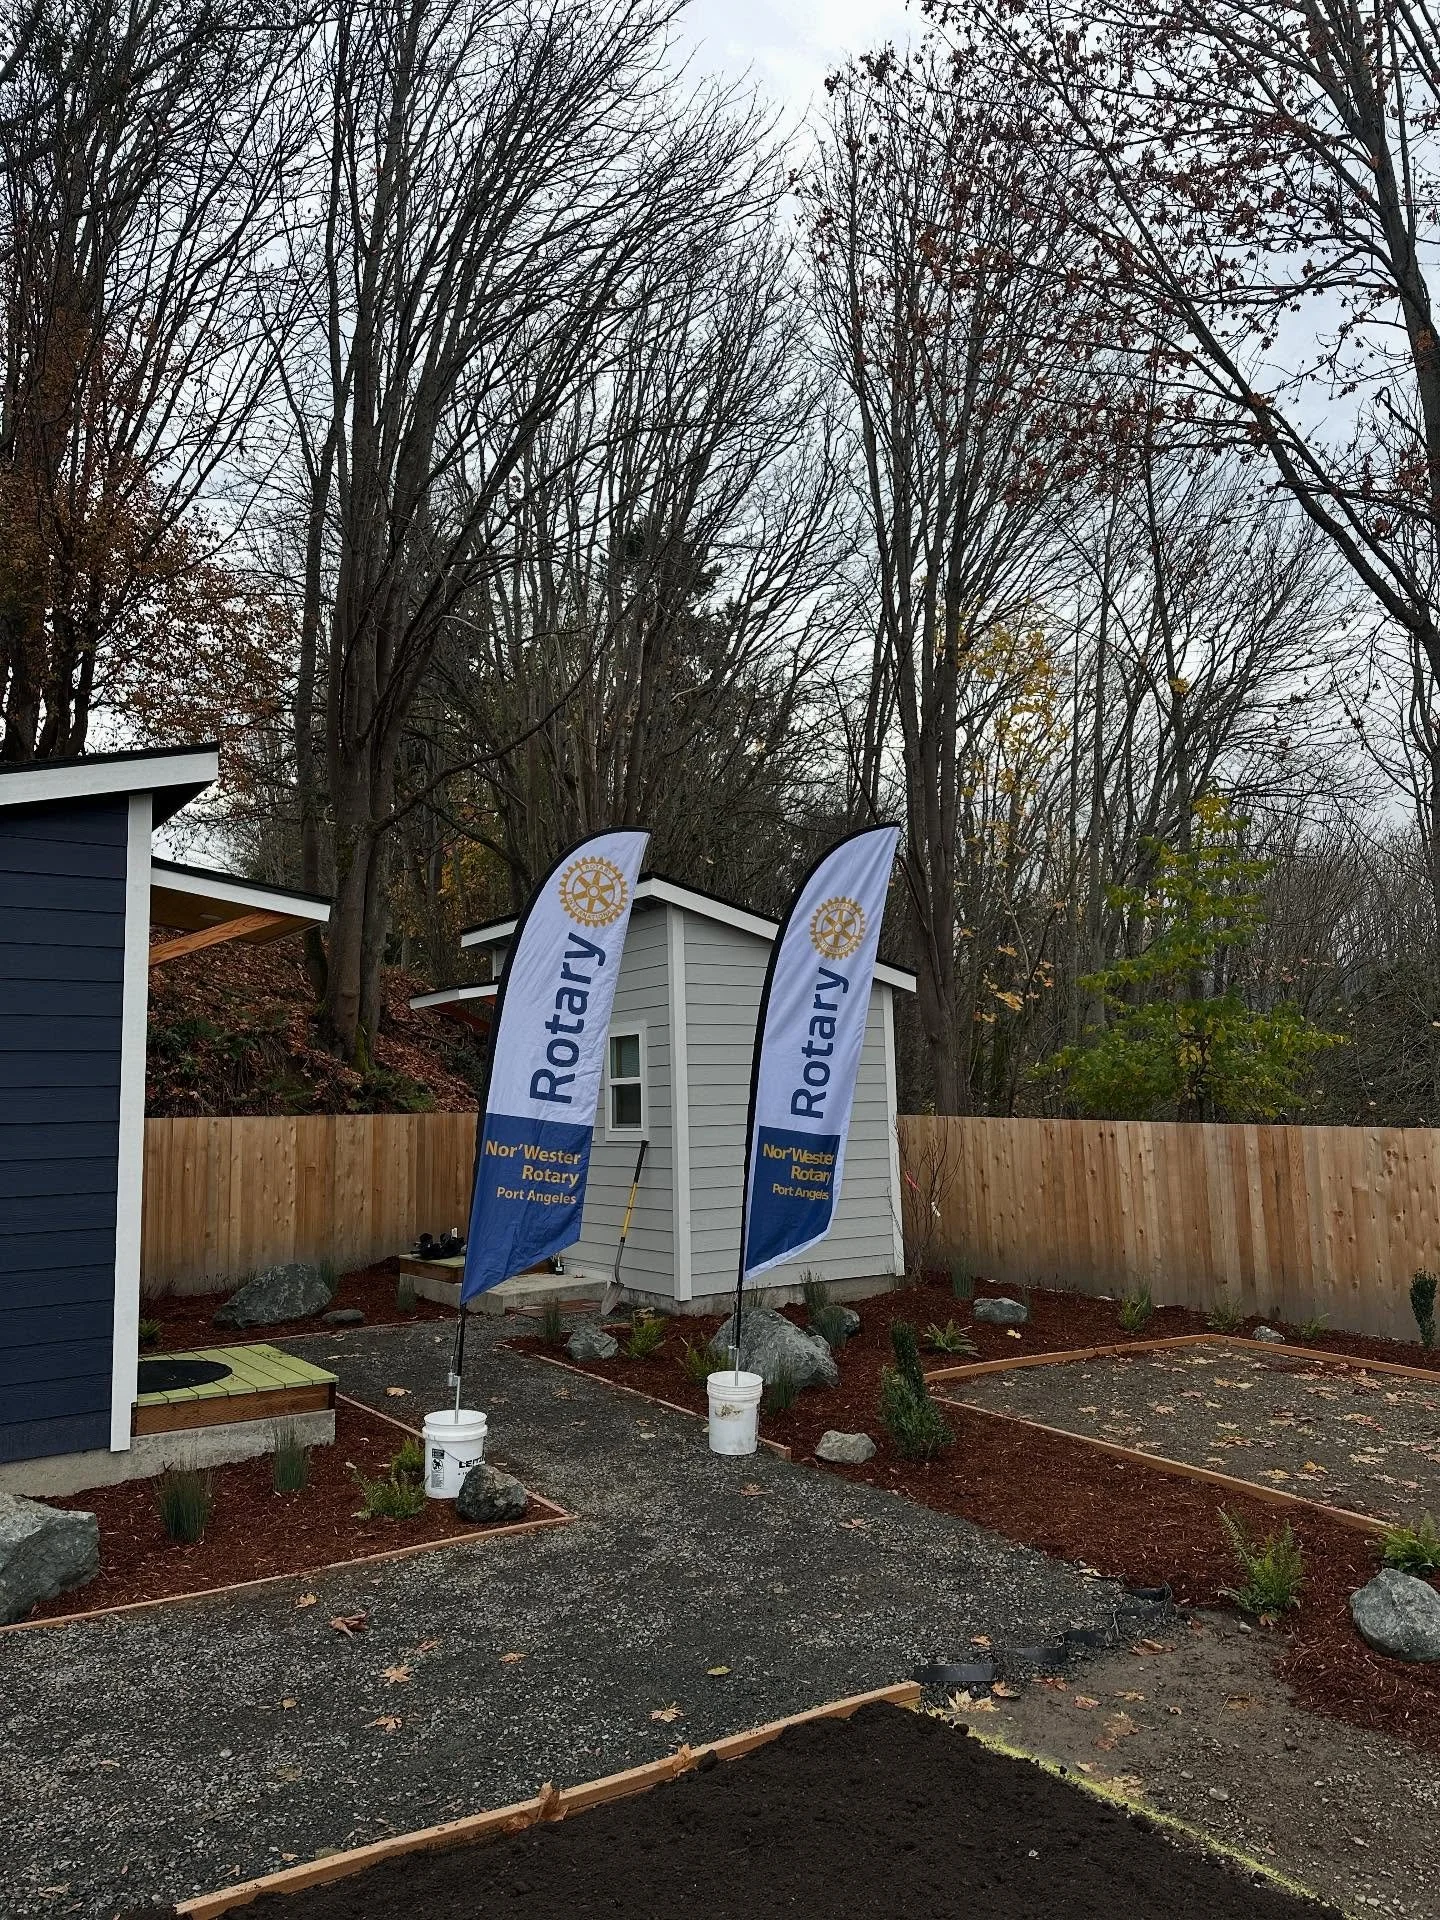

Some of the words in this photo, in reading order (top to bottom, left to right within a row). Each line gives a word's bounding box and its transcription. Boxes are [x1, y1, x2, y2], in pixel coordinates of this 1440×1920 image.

[585, 864, 613, 877] ROTARY
[567, 897, 617, 919] INTERNATIONAL
[529, 931, 606, 1104] Rotary
[790, 966, 850, 1119] Rotary
[485, 1140, 581, 1165] Nor'Wester
[522, 1165, 580, 1188] Rotary
[496, 1186, 524, 1200] Port
[527, 1190, 577, 1205] Angeles
[772, 1183, 794, 1196] Port
